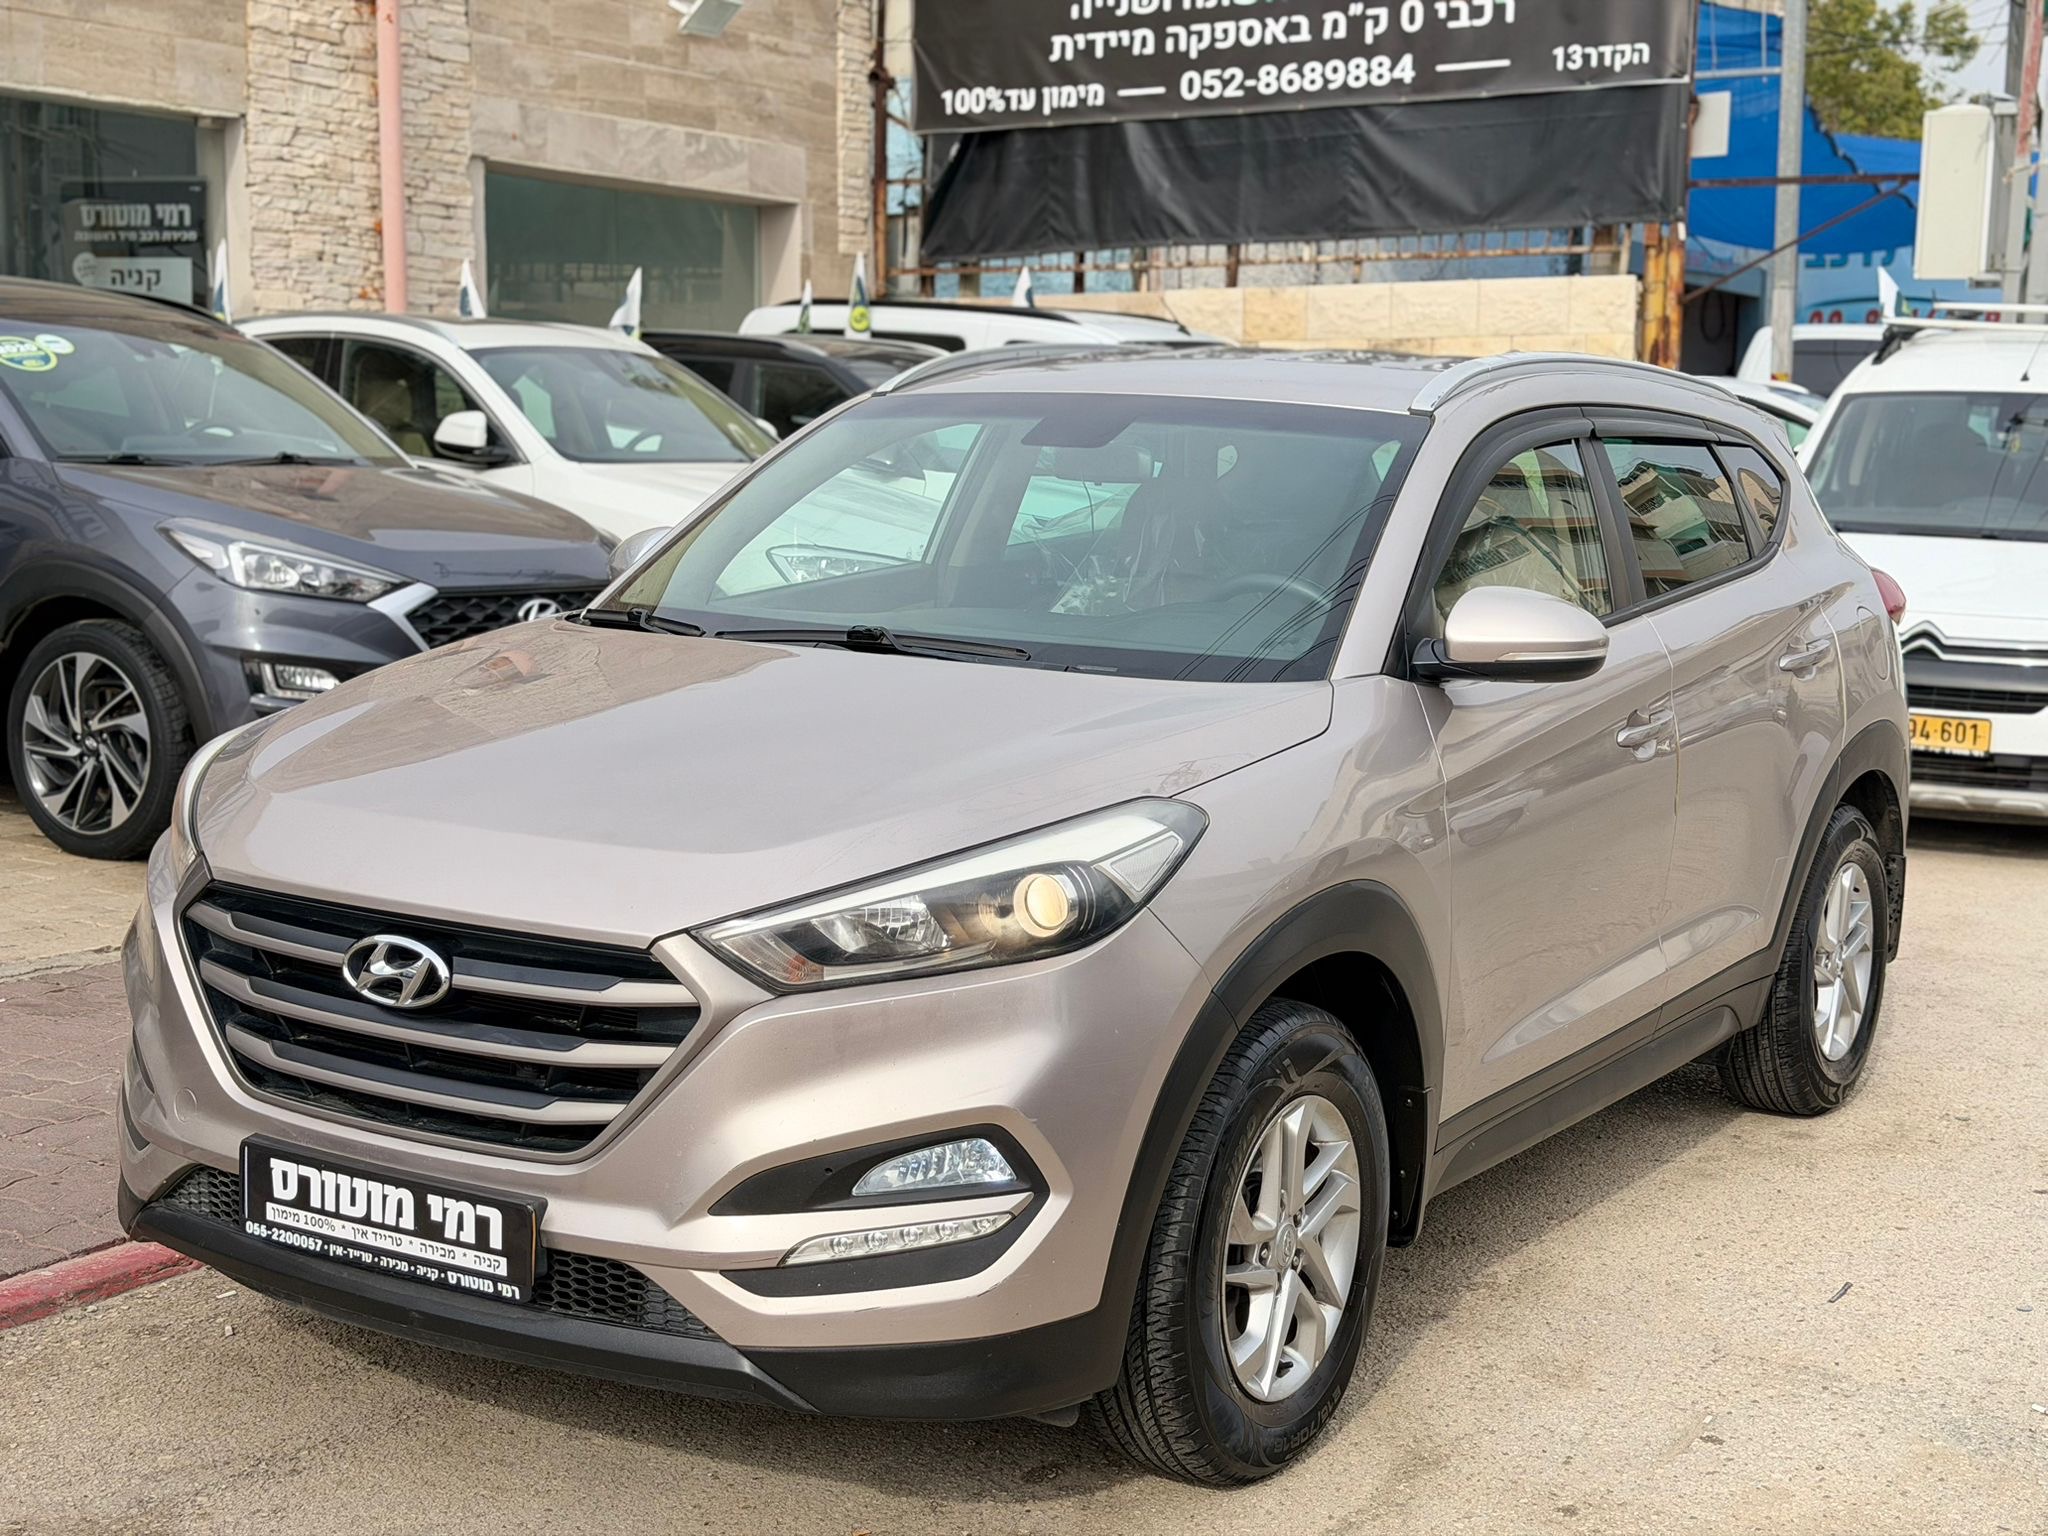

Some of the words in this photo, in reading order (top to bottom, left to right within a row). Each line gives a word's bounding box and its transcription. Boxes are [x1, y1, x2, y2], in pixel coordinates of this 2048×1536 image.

[1400, 0, 1425, 34] 0
[1434, 0, 1516, 29] רכבי
[1049, 27, 1155, 62] מיידית
[1165, 12, 1312, 60] באספקה
[1179, 53, 1416, 101] 052-8689884
[1041, 83, 1105, 116] מימון
[80, 204, 151, 227] מוטורס
[155, 203, 191, 227] רמי
[111, 269, 162, 292] קניה
[270, 1157, 415, 1230] מוטורס
[271, 1206, 300, 1223] מימון
[304, 1214, 336, 1232] 100%
[427, 1193, 503, 1250] רמי
[245, 1220, 322, 1251] 055-2200057
[351, 1226, 369, 1241] אין
[372, 1231, 403, 1247] טרייד
[420, 1242, 456, 1260] מכירה
[473, 1254, 501, 1271] קניה
[380, 1256, 409, 1271] מכירה
[416, 1264, 439, 1281] קניה
[447, 1271, 494, 1293] מוטורס
[497, 1282, 520, 1299] רמי
